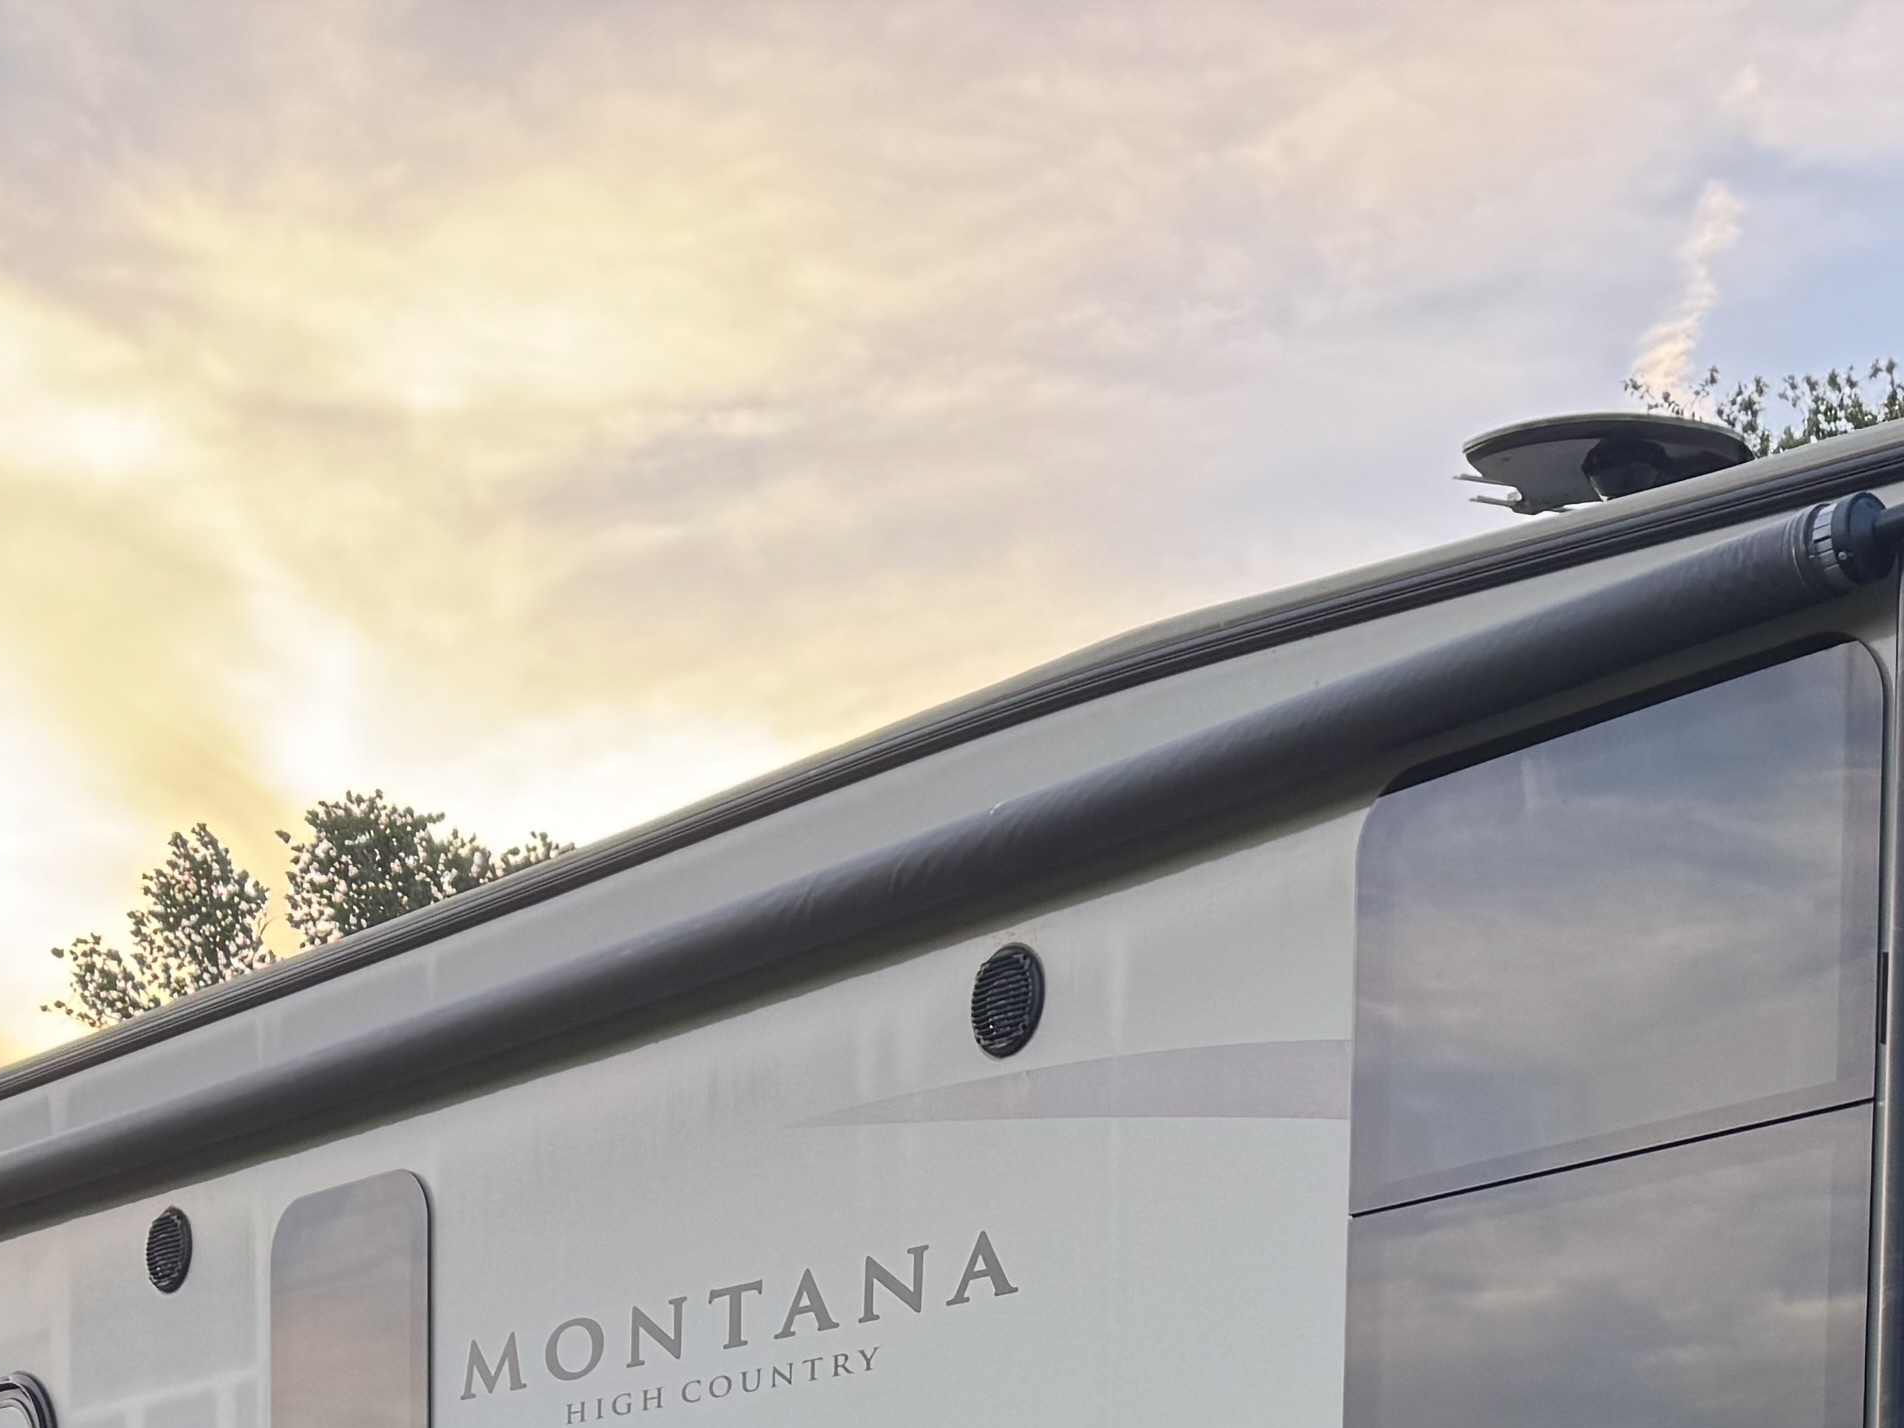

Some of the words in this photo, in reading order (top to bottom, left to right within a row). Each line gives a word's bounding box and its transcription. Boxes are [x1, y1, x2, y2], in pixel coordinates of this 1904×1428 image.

[459, 1229, 1019, 1401] MONTANA
[565, 1385, 665, 1426] HIGH
[680, 1345, 882, 1404] COUNTRY
